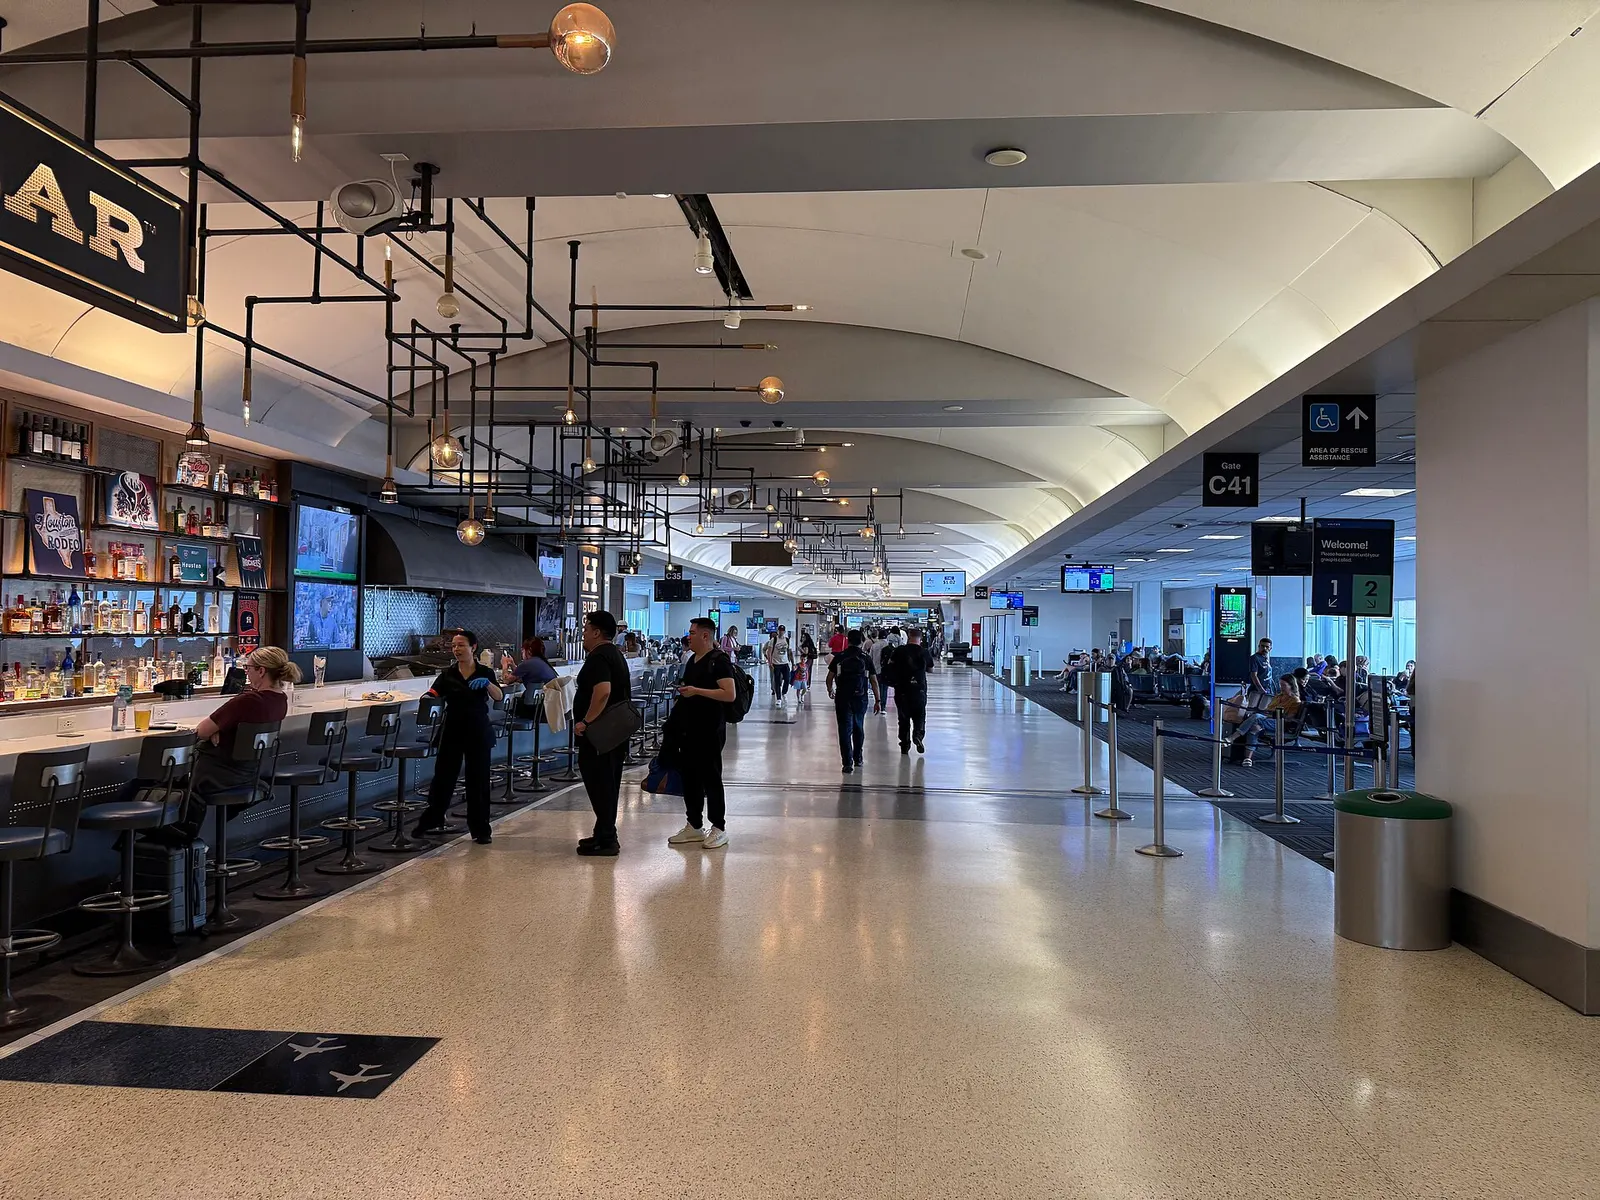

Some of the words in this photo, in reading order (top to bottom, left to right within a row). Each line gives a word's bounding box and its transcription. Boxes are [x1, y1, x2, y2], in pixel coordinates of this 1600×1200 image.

[1221, 462, 1241, 470] Gate
[1208, 475, 1251, 495] C41
[47, 536, 80, 550] RODEO
[1320, 539, 1369, 550] Welcome!
[582, 556, 598, 593] H
[665, 572, 682, 580] C35
[1330, 579, 1338, 596] 1
[1364, 580, 1378, 597] 2
[582, 601, 598, 613] BUR
